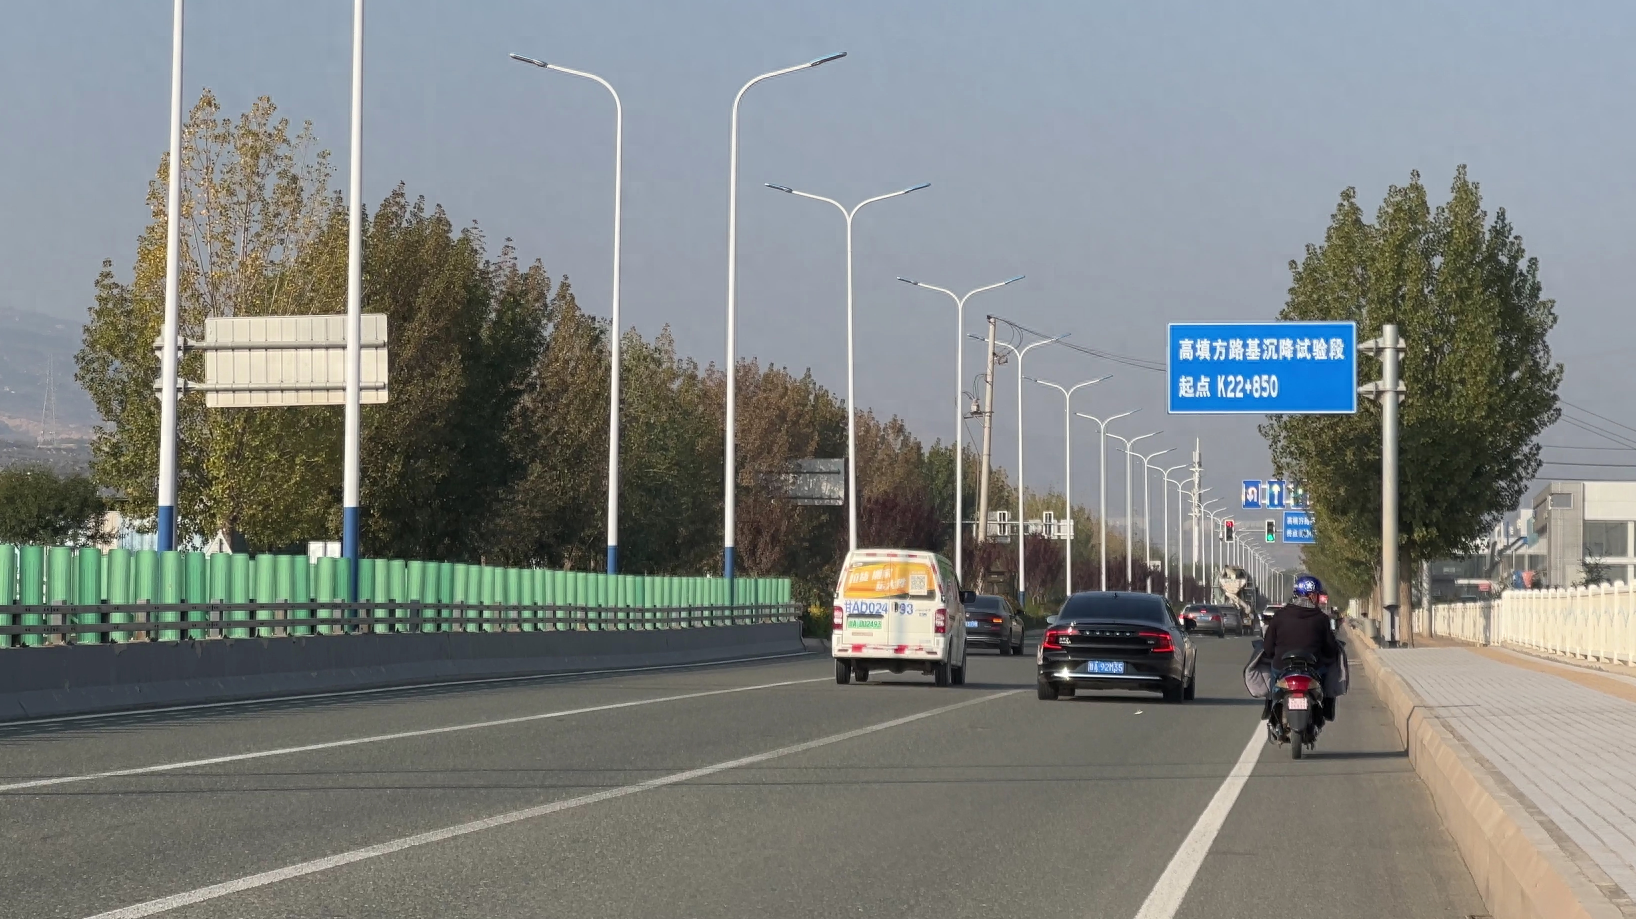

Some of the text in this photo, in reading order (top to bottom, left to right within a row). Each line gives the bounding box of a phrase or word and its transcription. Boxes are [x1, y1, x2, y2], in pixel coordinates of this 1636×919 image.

[1178, 338, 1346, 361] 高填方路基沉降试验段
[1178, 374, 1279, 398] 起点 K22+850
